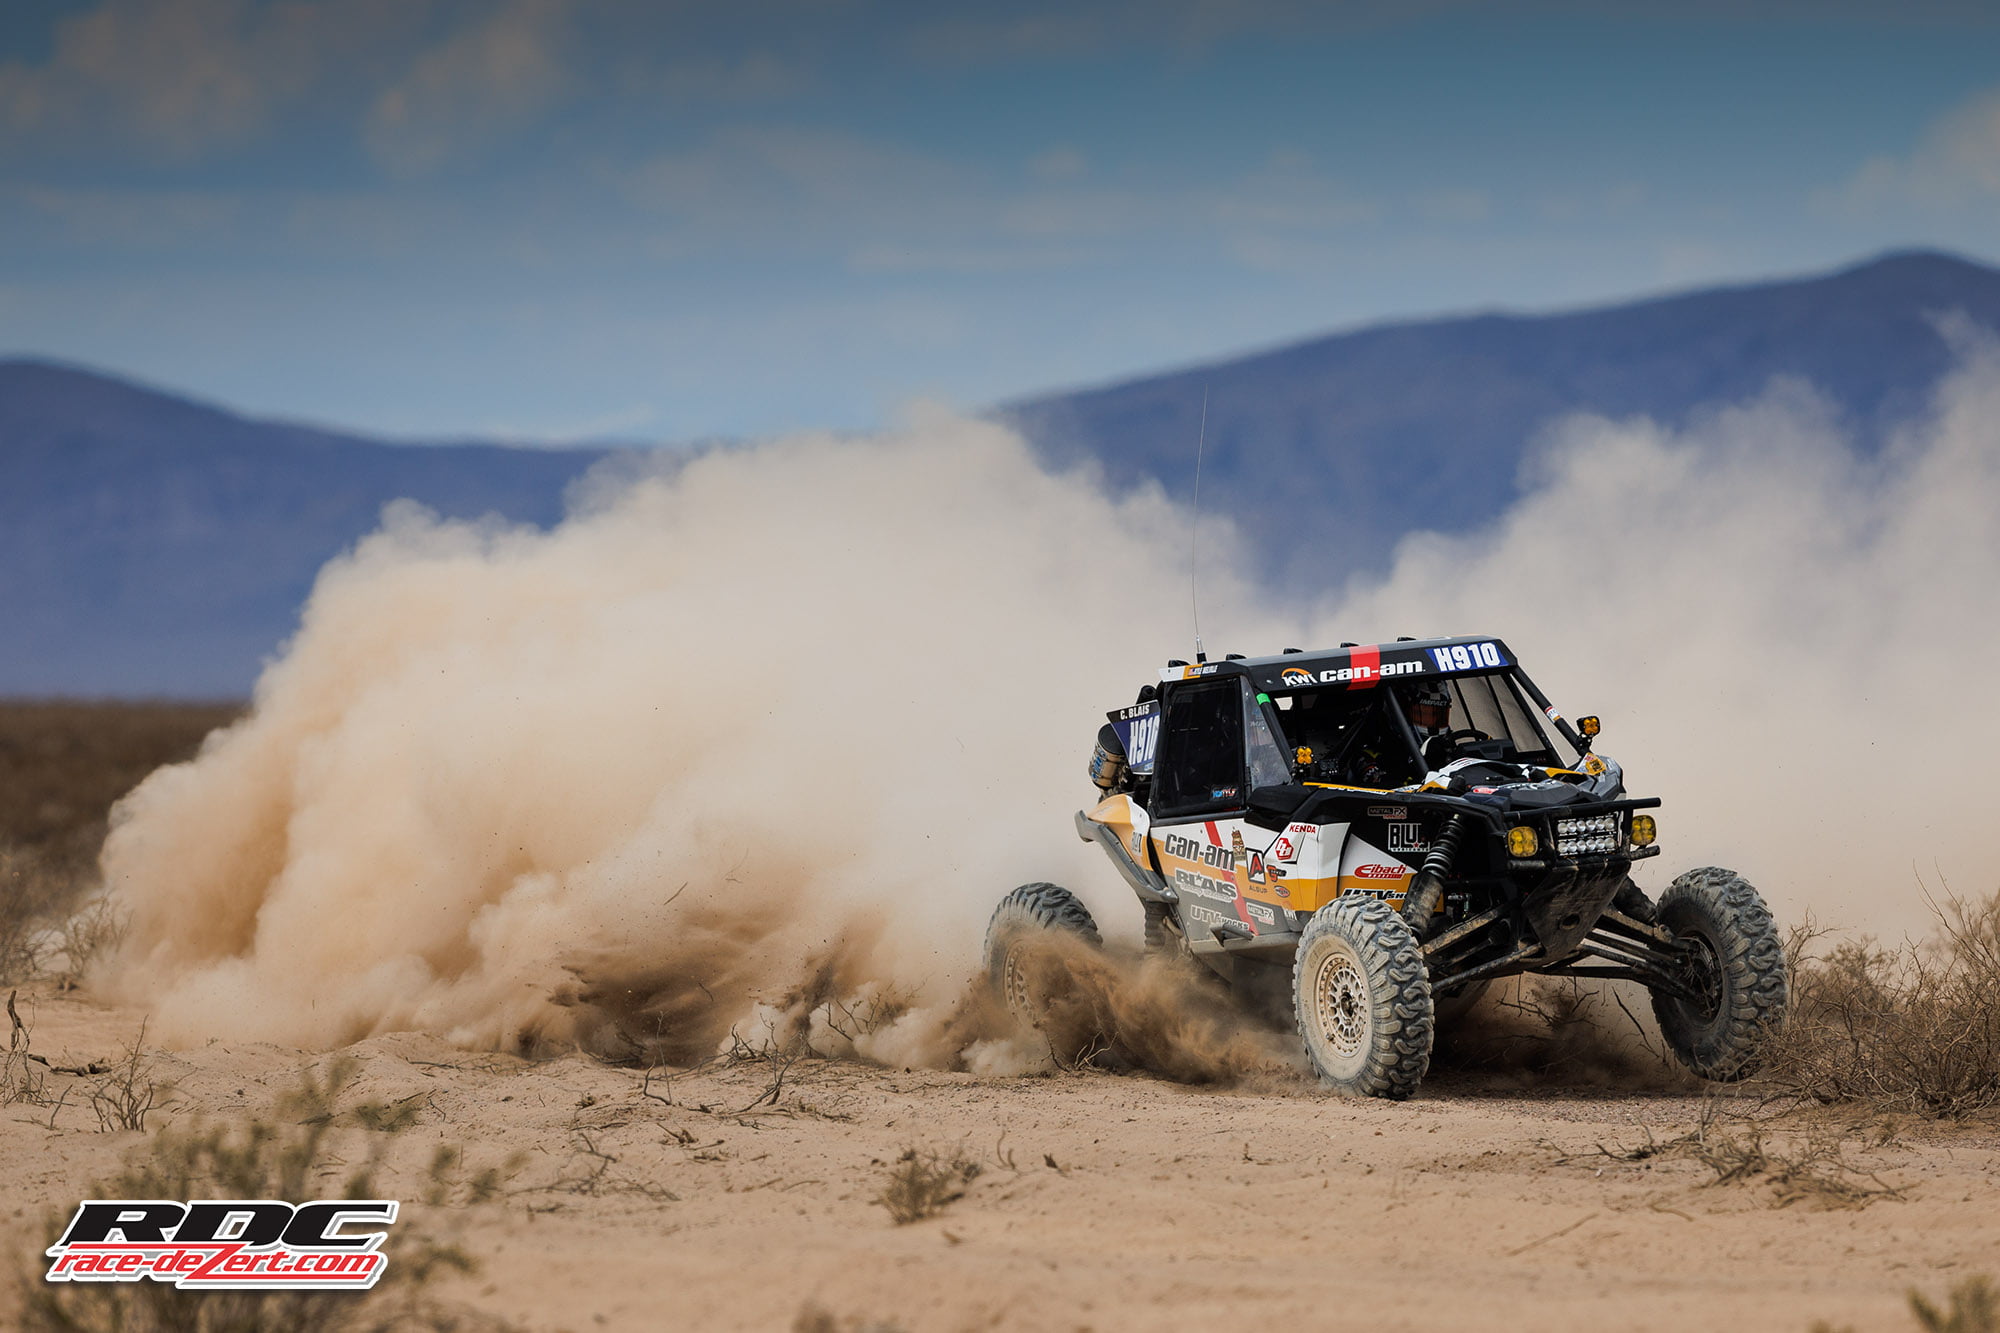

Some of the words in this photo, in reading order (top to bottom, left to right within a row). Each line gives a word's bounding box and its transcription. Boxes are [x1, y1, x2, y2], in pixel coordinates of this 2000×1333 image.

[1433, 642, 1501, 672] H910
[1320, 660, 1424, 683] can-am
[1128, 704, 1150, 718] BLAIS
[1128, 714, 1160, 766] H910
[1289, 825, 1316, 834] KENDA
[1164, 834, 1236, 872] can-am
[1175, 869, 1237, 898] BLAIS
[1354, 863, 1407, 879] Eibach
